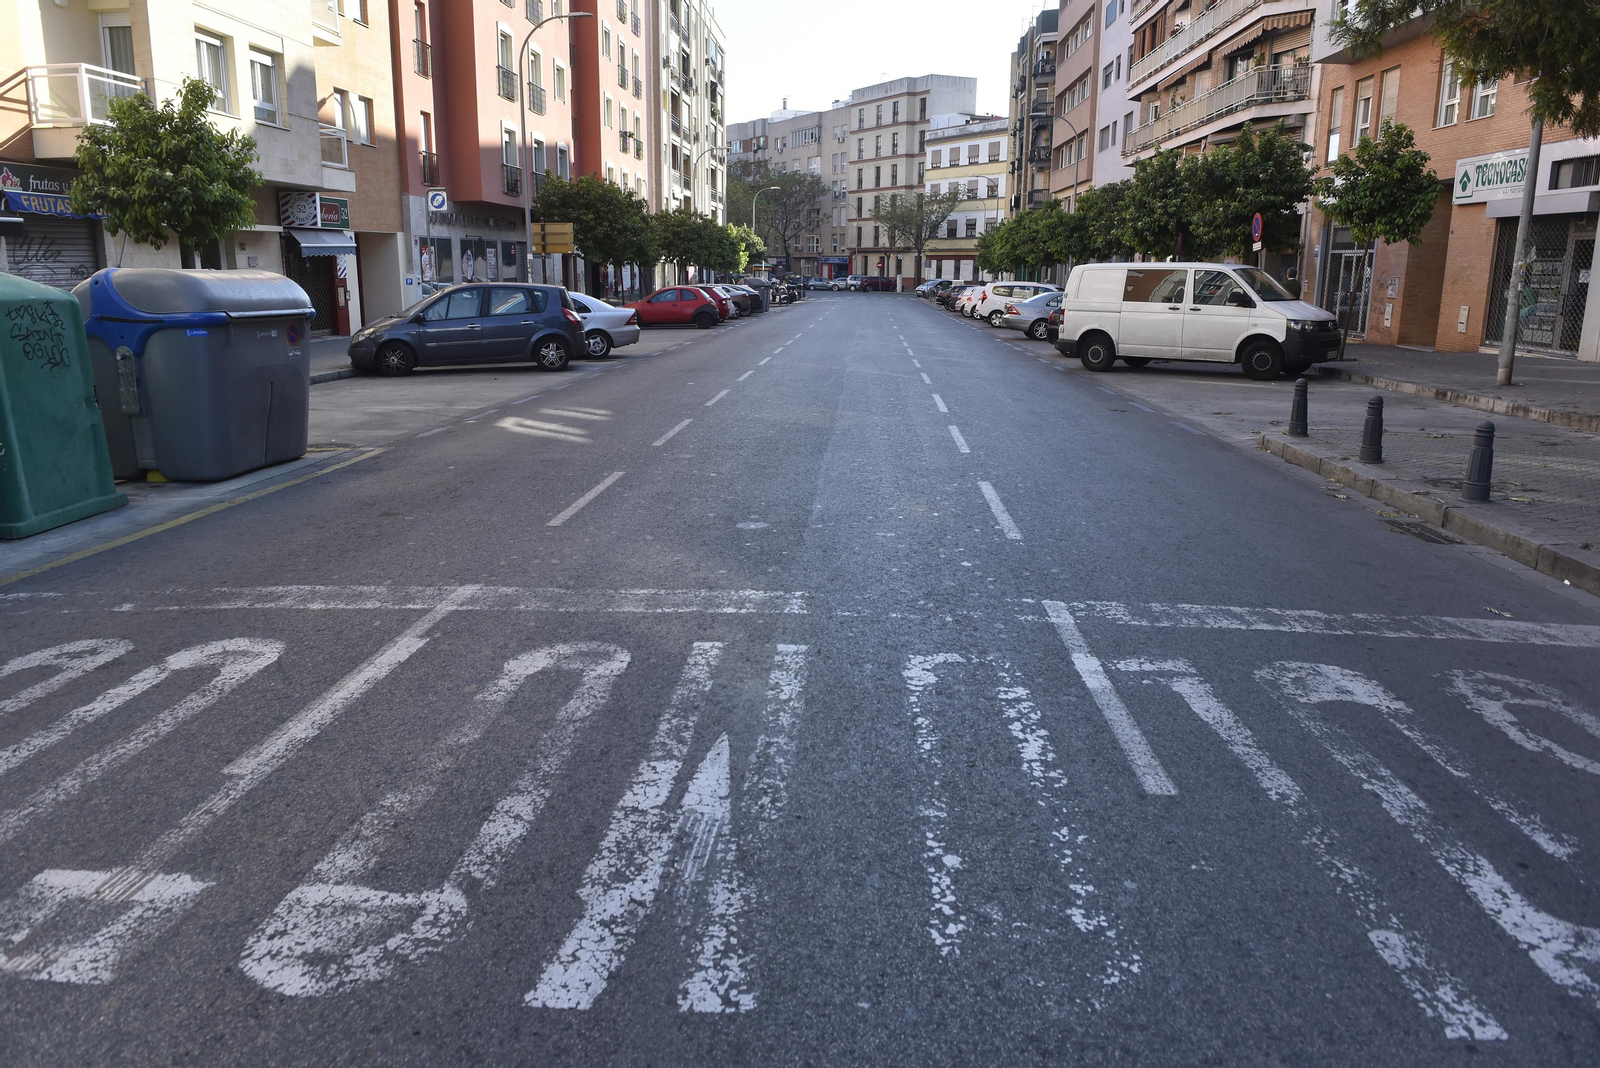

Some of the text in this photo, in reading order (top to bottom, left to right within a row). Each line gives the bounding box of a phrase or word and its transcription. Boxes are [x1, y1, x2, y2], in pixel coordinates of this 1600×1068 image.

[28, 174, 60, 192] frutas
[21, 195, 73, 214] FRUTAS
[296, 204, 306, 214] 52
[321, 207, 338, 221] bería
